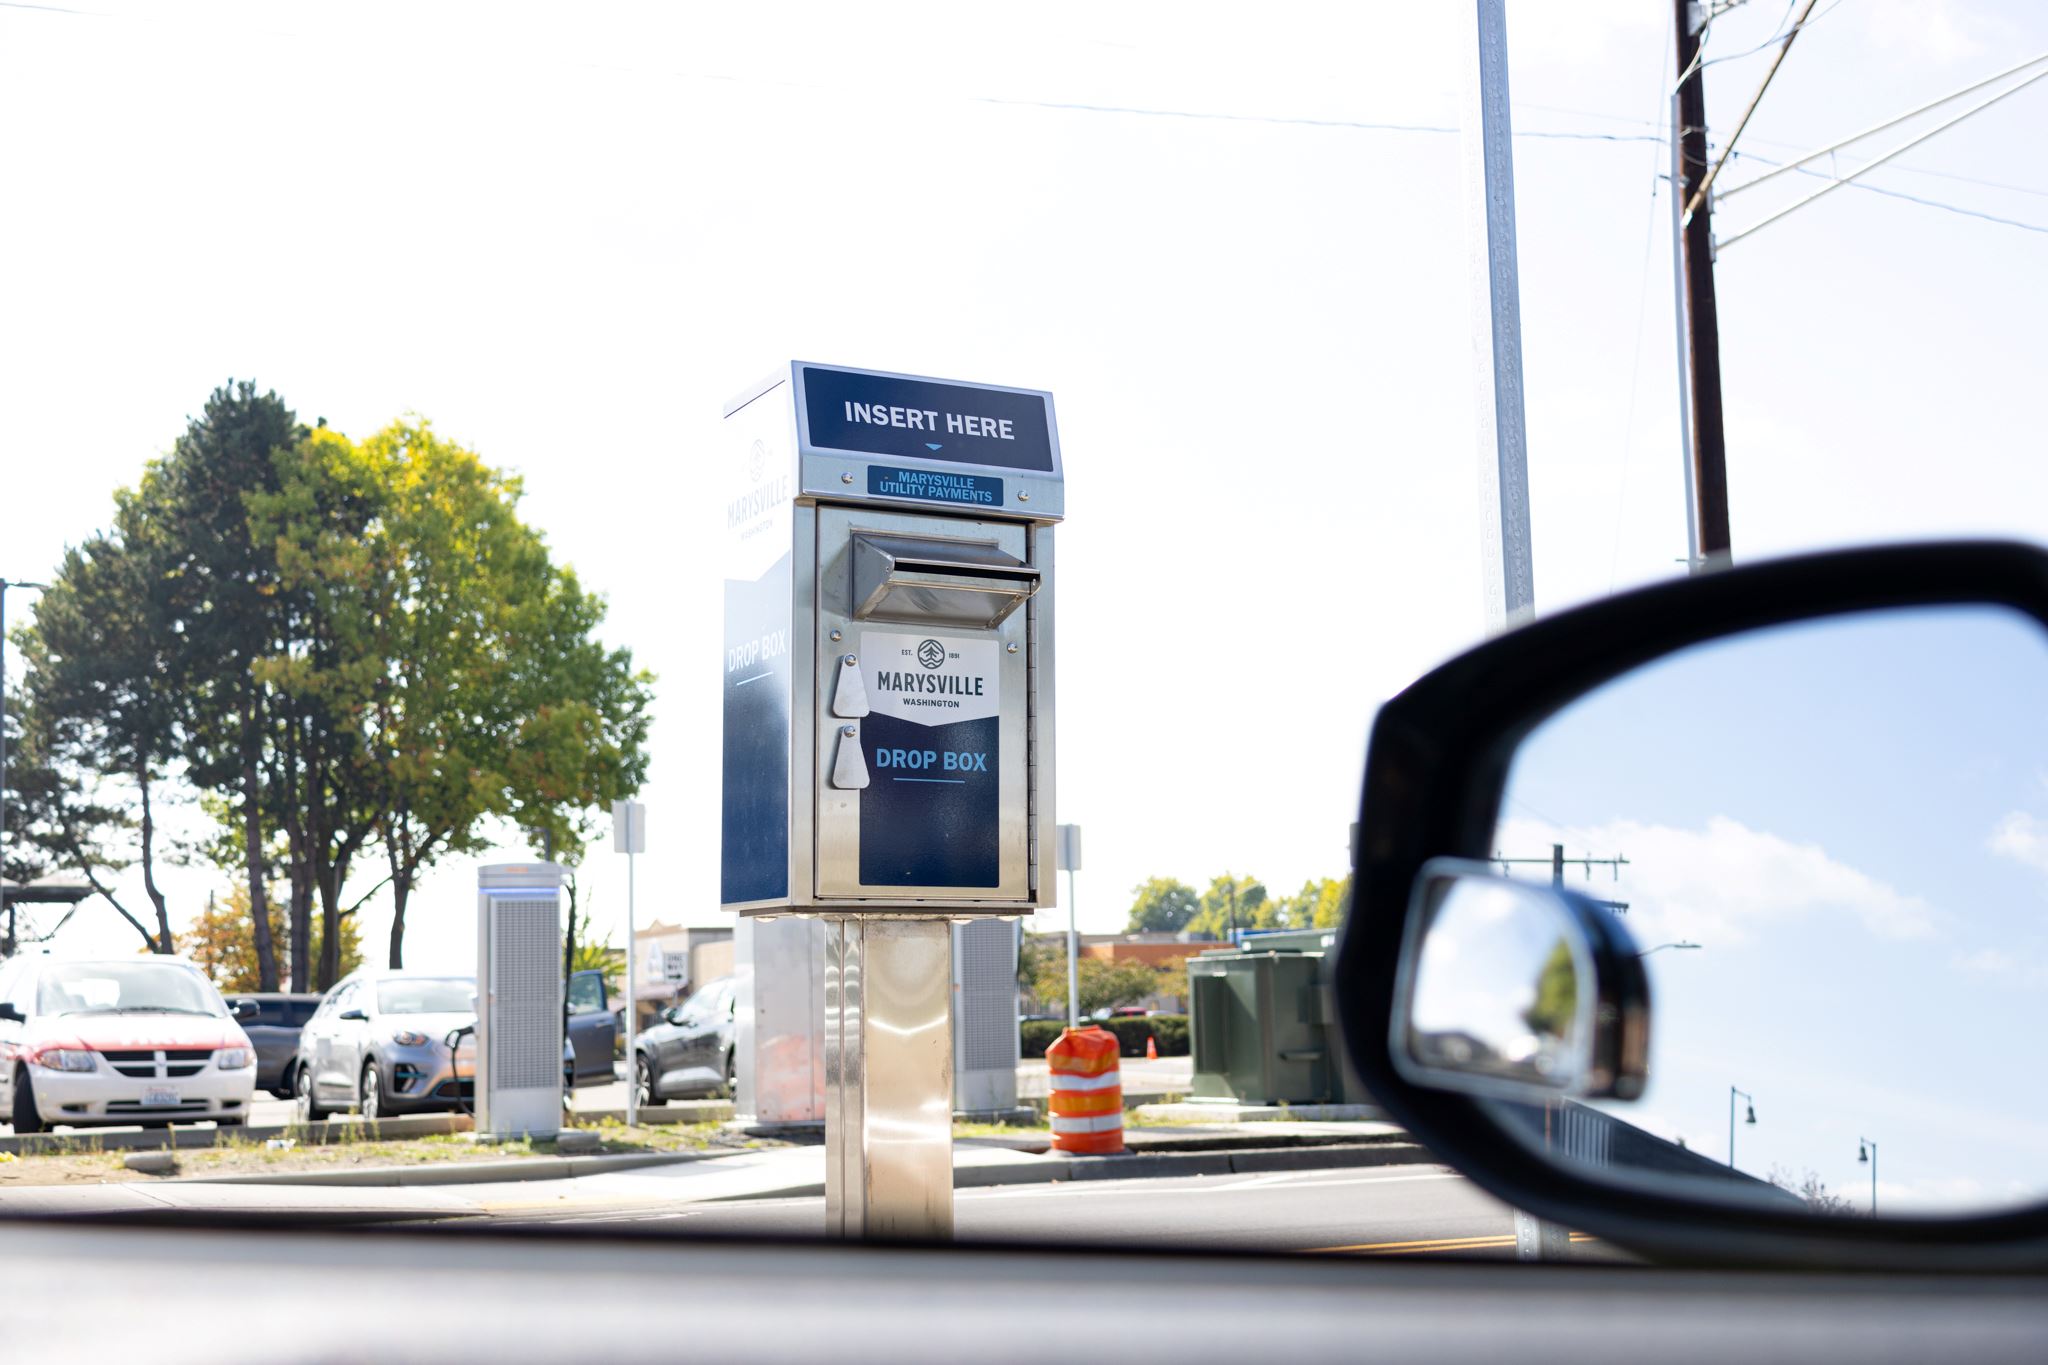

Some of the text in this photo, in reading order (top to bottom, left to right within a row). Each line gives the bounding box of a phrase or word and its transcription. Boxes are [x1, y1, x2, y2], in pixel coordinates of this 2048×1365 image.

[845, 401, 1015, 440] INSERT HERE
[880, 481, 993, 502] UTILITY PAYMENTS
[899, 471, 975, 489] MARYSVILLE
[727, 474, 788, 530] MARYSVILLE
[729, 628, 786, 673] DROP BOX
[878, 671, 983, 696] MARYSVILLE
[903, 698, 960, 708] WASHINGTON
[876, 748, 988, 772] DROP BOX
